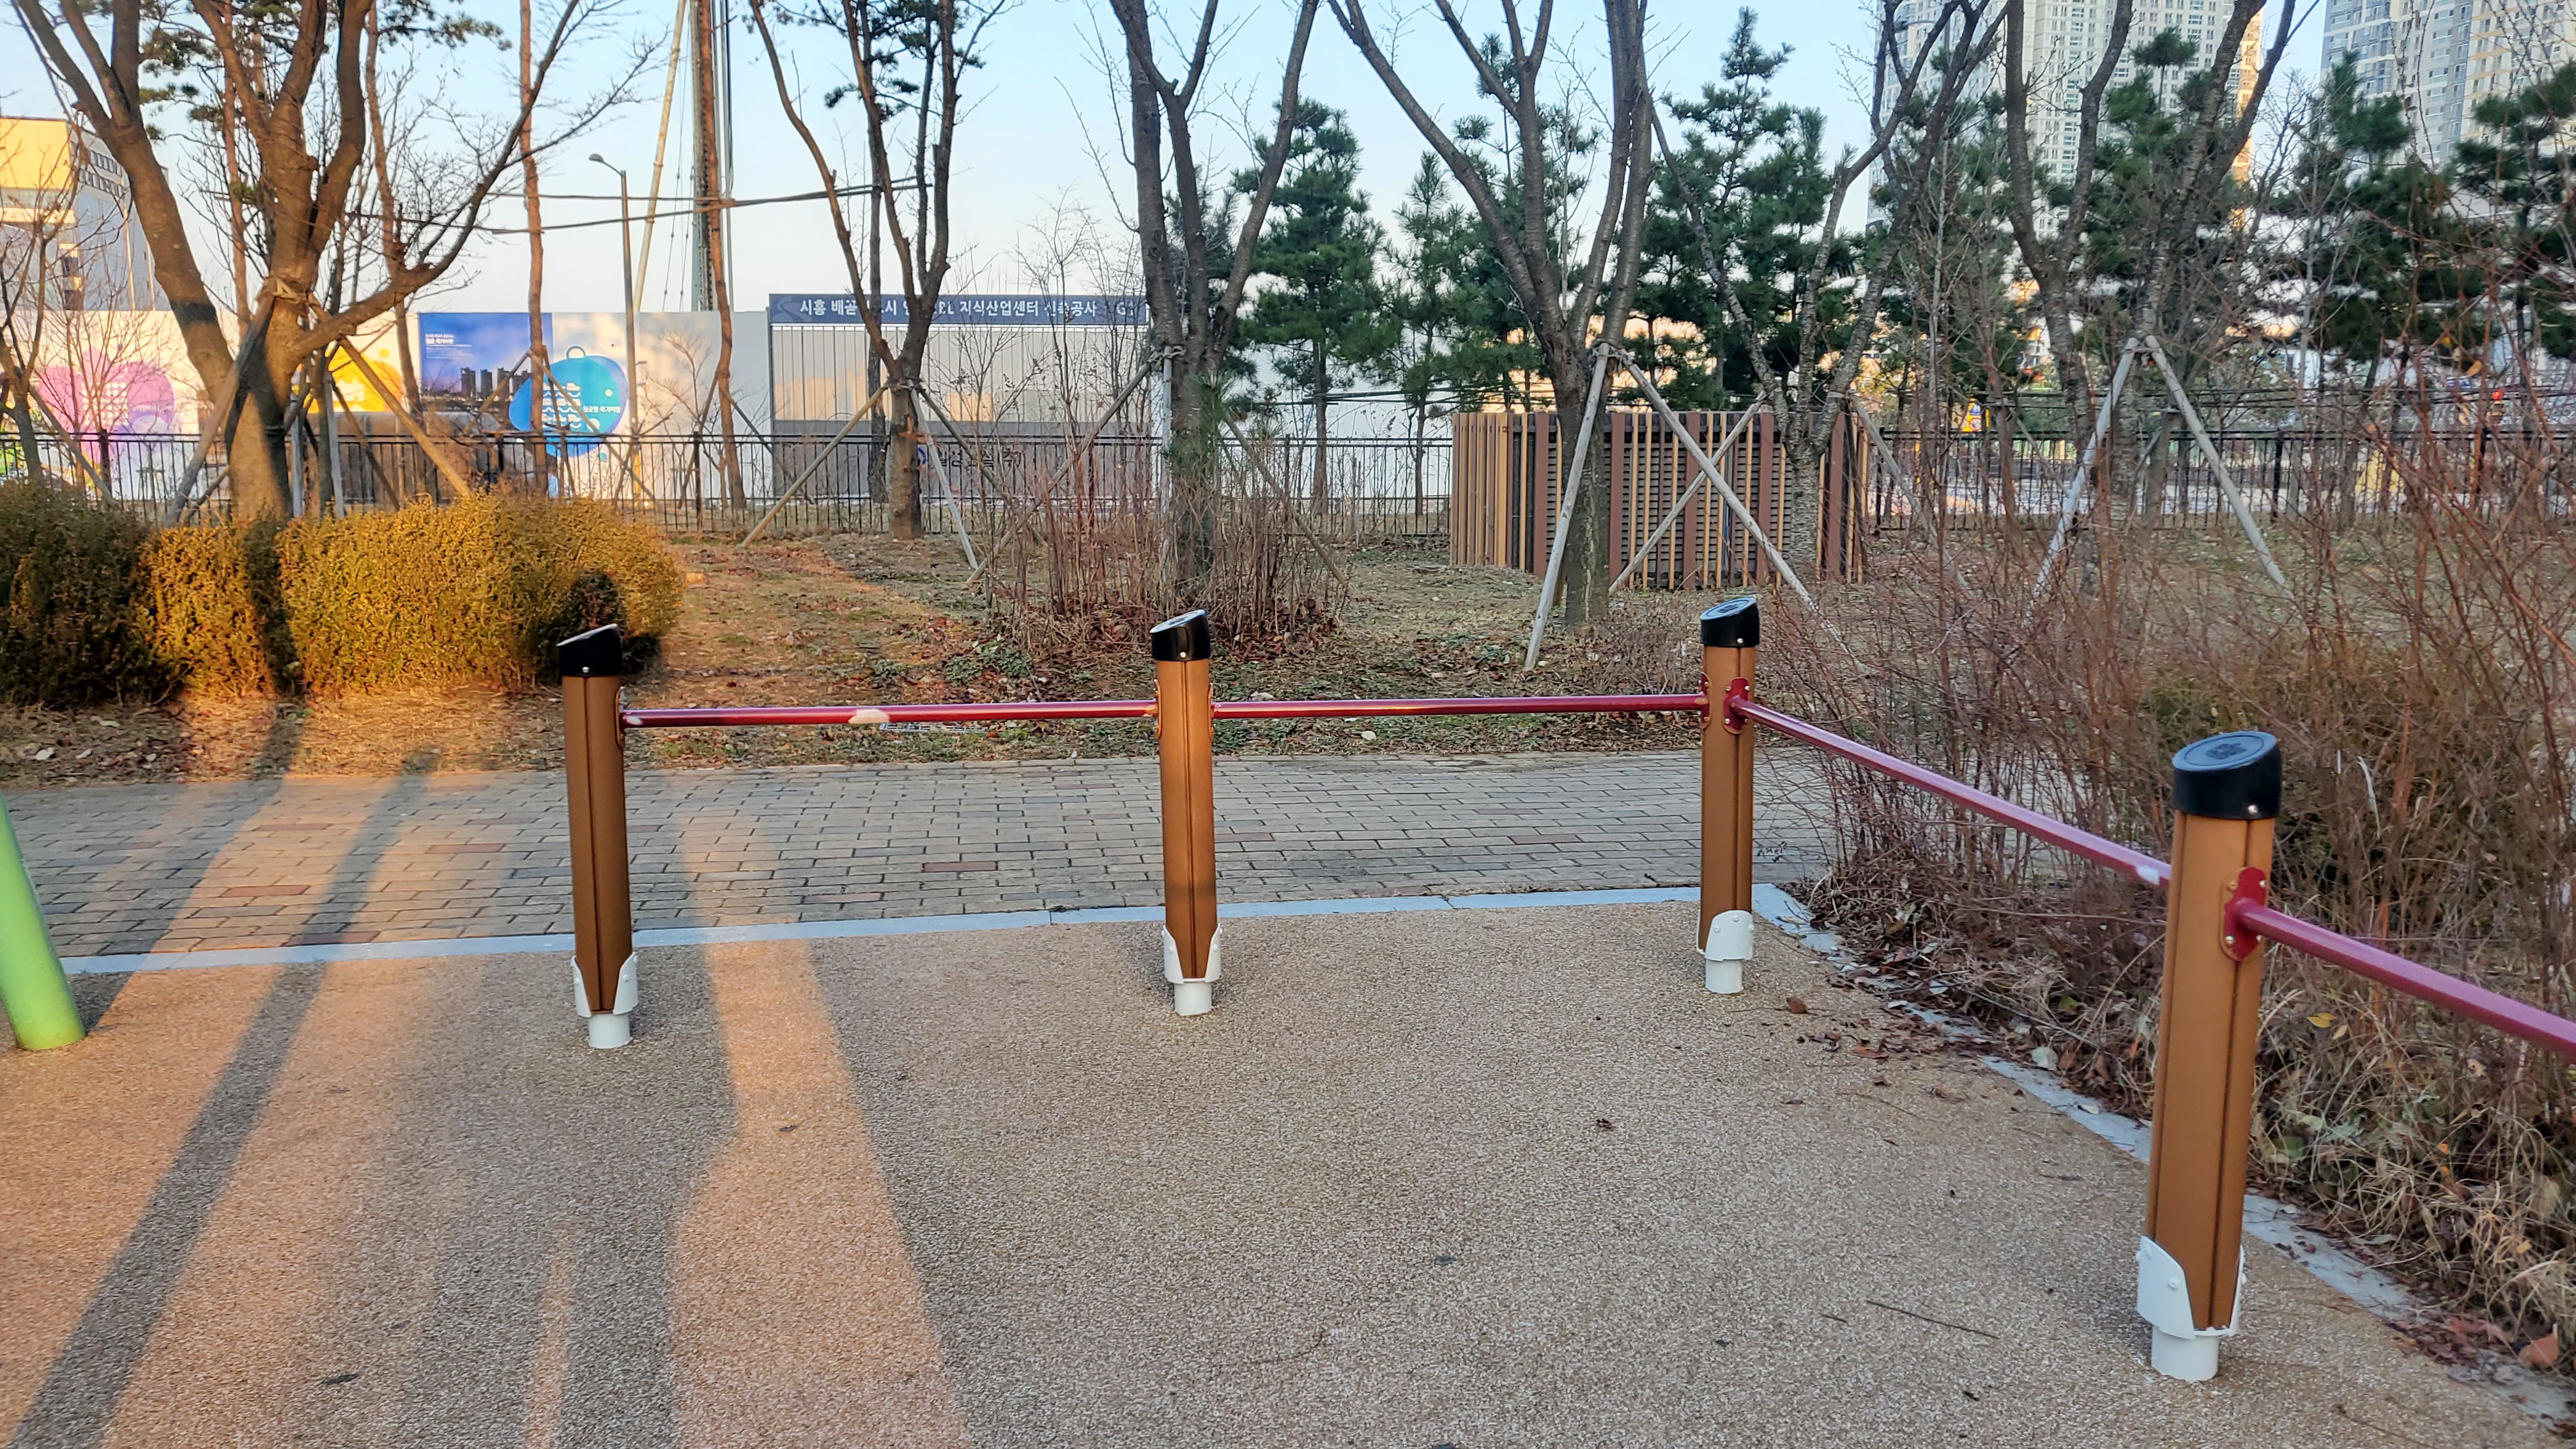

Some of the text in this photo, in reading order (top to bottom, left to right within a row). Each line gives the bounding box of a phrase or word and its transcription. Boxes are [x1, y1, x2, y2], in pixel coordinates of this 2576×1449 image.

[800, 299, 827, 316] 시흥
[831, 299, 897, 316] 배곧시
[960, 300, 1038, 317] 지식산업센터
